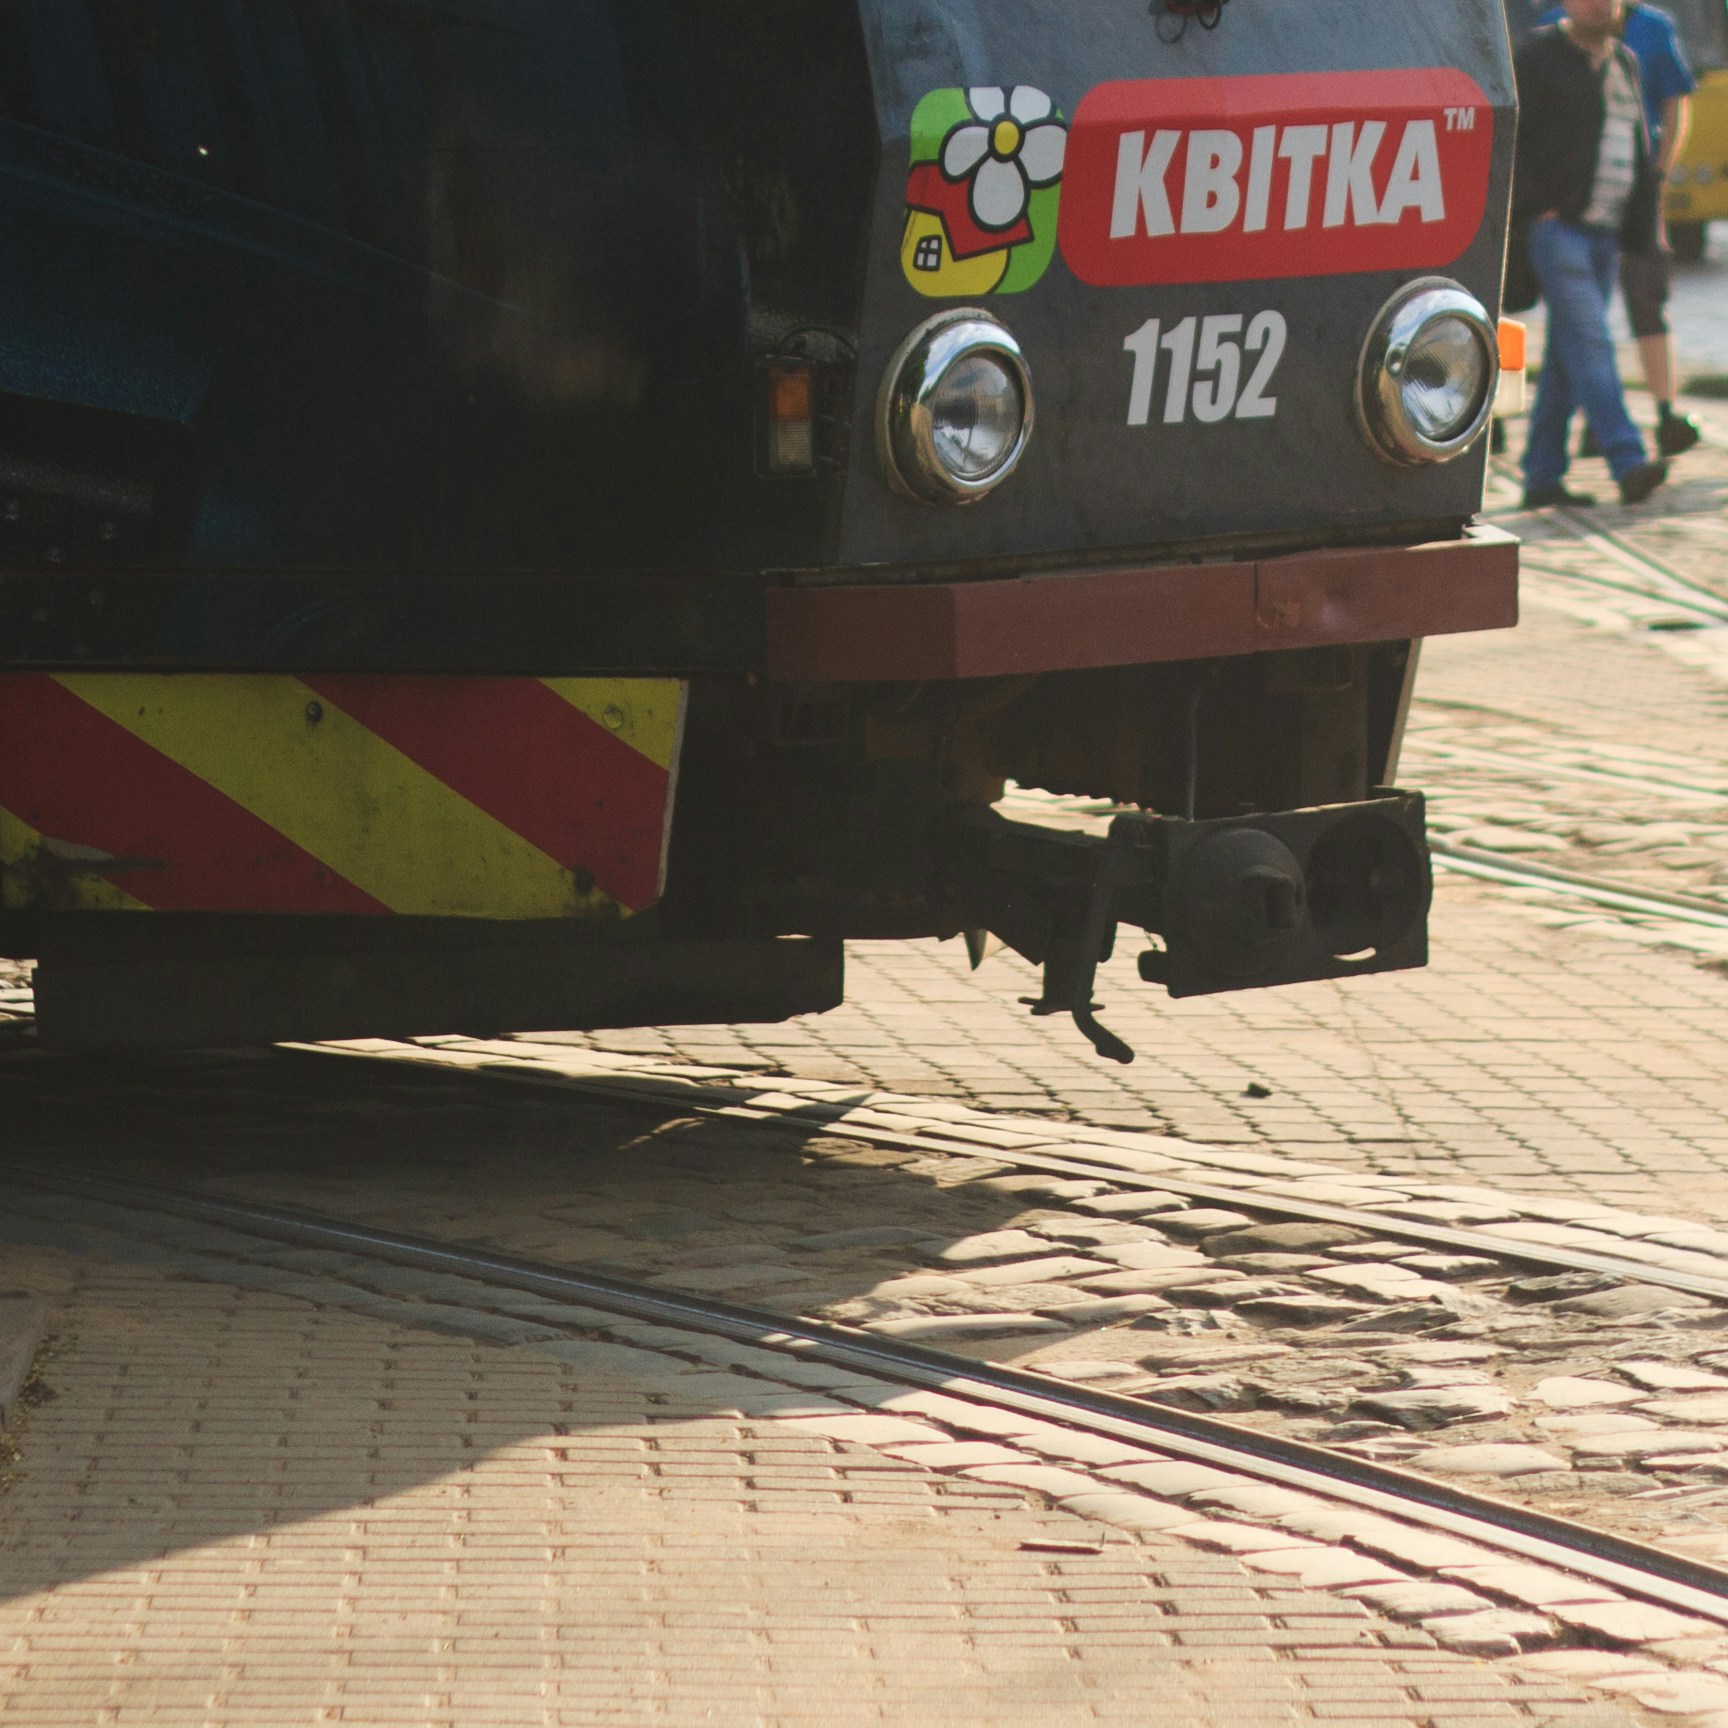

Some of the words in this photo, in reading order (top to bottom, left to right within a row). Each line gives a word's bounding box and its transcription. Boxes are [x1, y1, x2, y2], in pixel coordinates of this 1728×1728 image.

[1109, 119, 1445, 240] КВІТКА
[1444, 106, 1476, 132] TM
[1122, 309, 1288, 426] 1152
